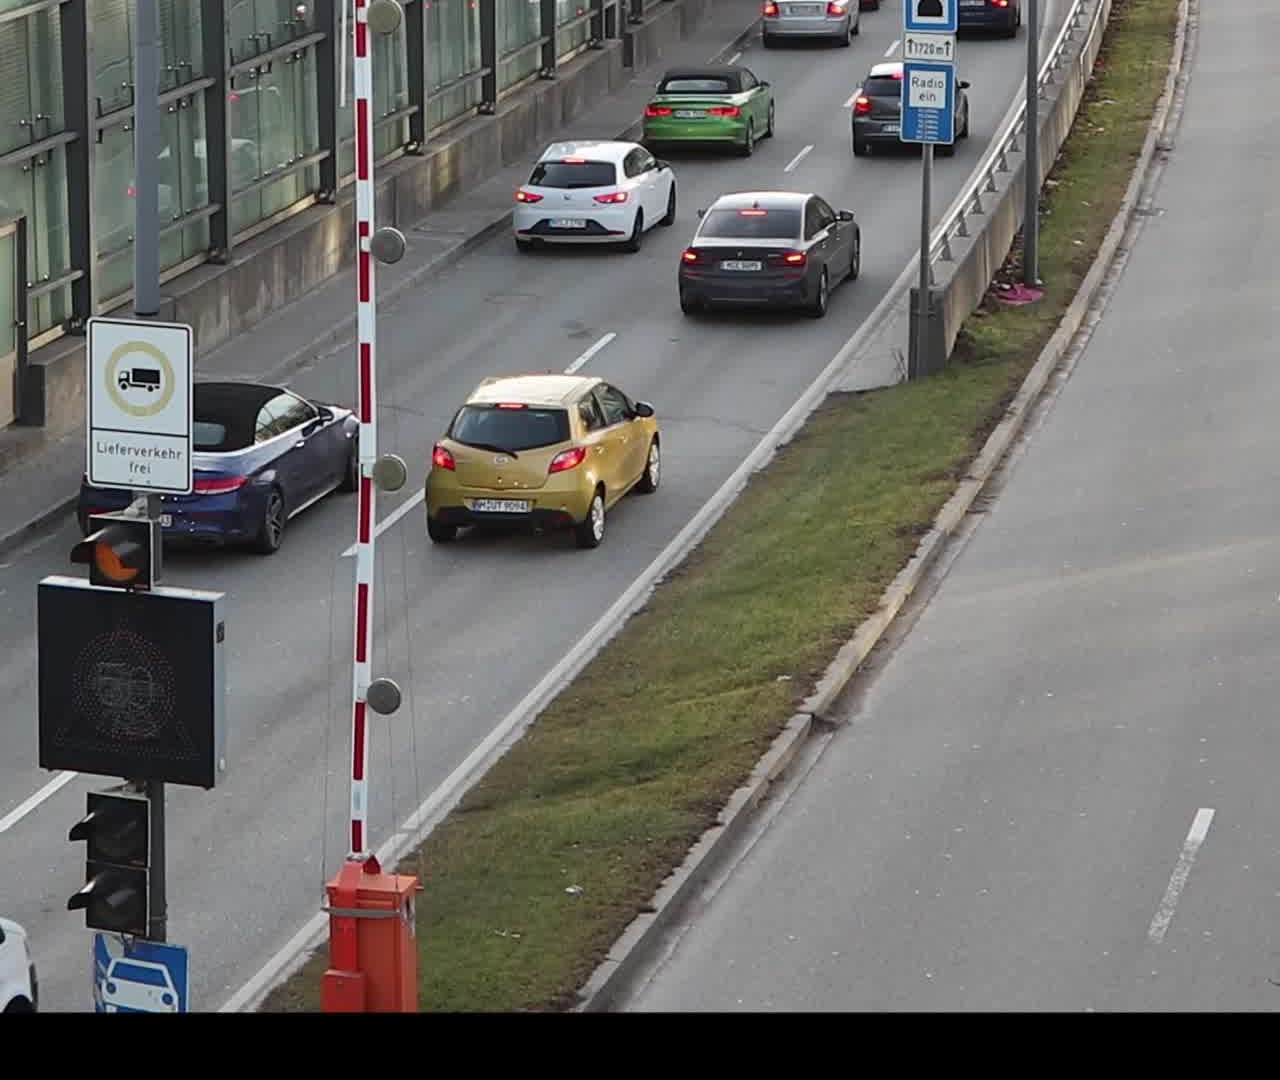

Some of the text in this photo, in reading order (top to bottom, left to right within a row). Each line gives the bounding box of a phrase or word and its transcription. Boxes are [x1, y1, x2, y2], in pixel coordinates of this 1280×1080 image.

[912, 77, 944, 89] Radio
[919, 92, 936, 101] ein
[96, 441, 183, 460] Lieferverkehr
[129, 461, 151, 474] frei
